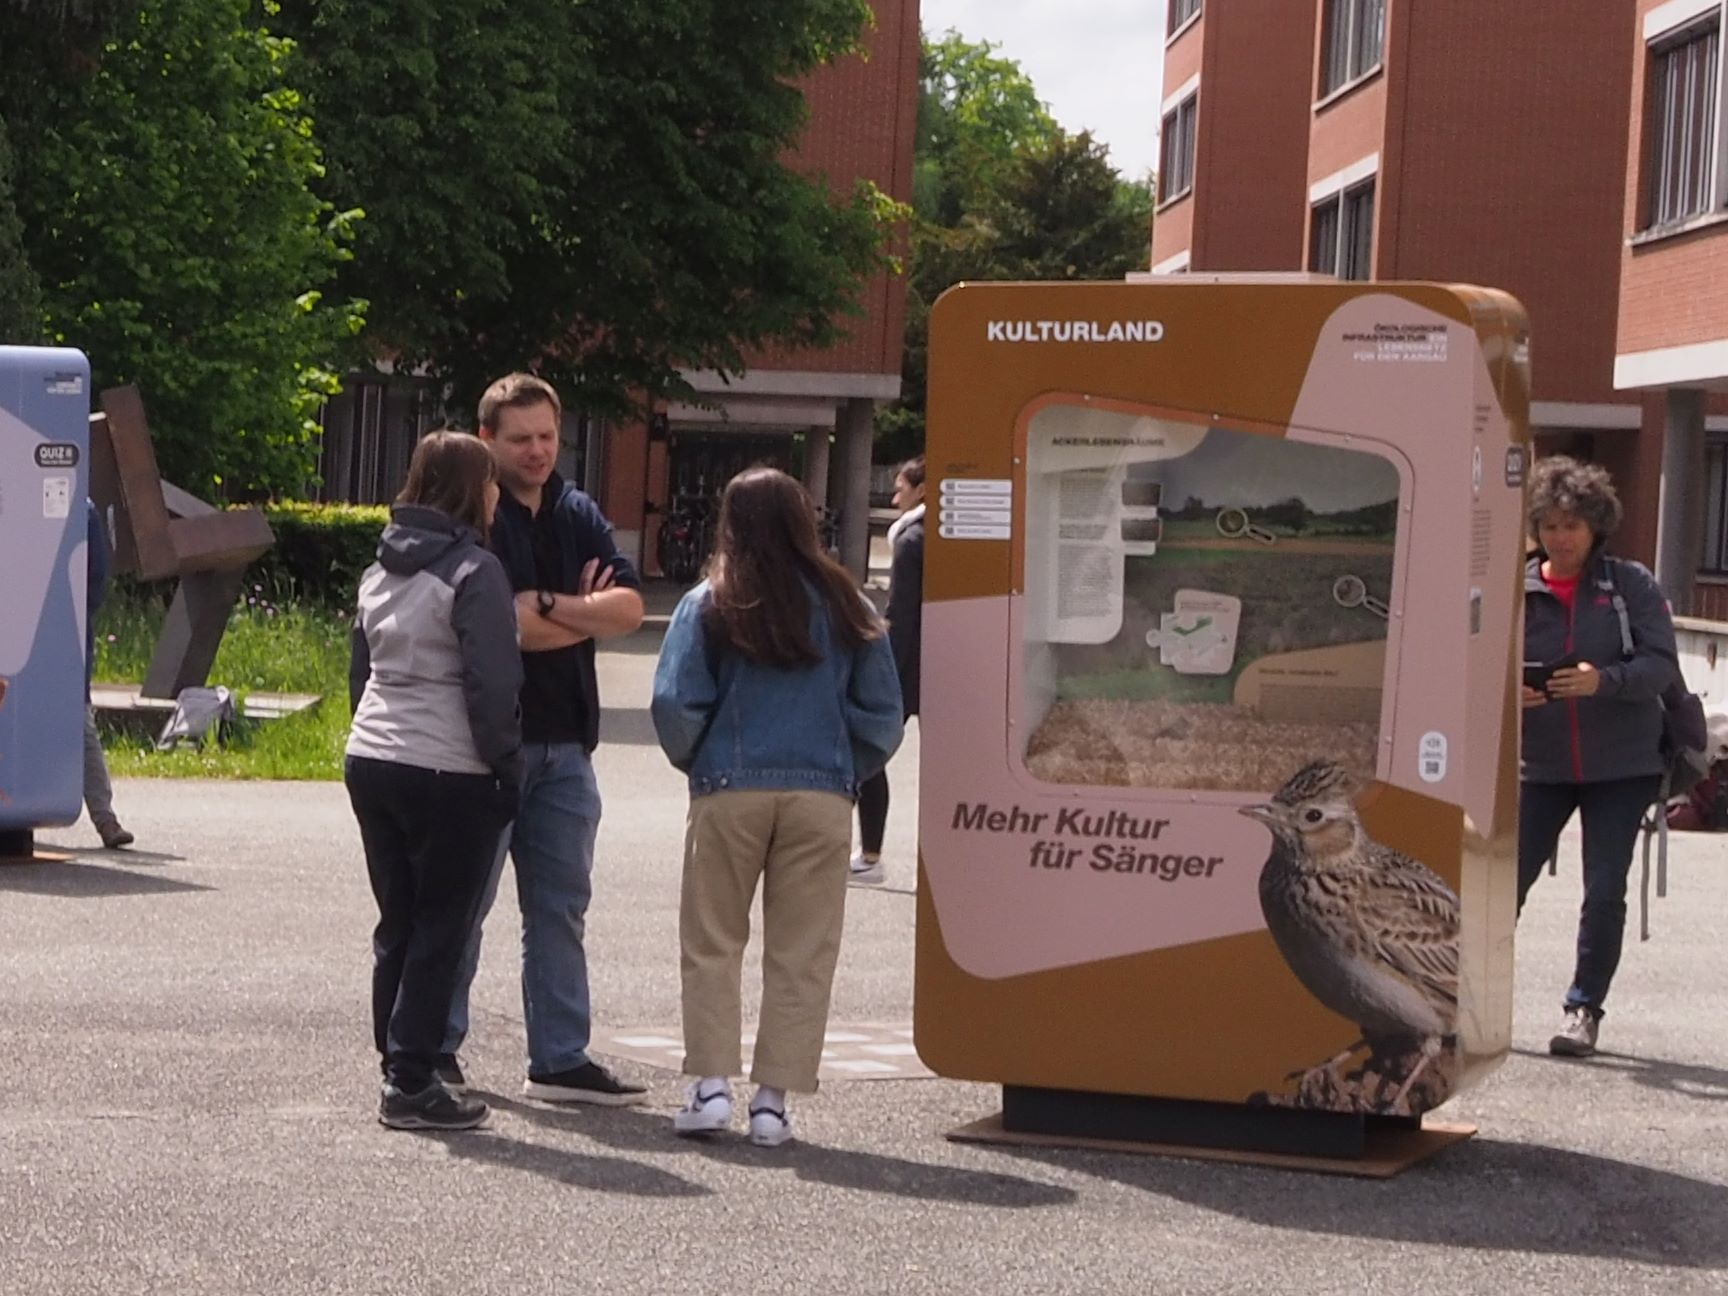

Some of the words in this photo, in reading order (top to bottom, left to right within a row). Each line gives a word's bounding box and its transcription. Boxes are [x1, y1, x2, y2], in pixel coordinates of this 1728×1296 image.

[987, 320, 1164, 342] KULTURLAND
[1342, 334, 1426, 342] INFRASTRUKTUR
[40, 447, 64, 458] QUIZ
[951, 803, 1048, 834] Mehr
[1055, 808, 1169, 840] Kultur
[1029, 841, 1082, 869] für
[1089, 844, 1223, 881] Sänger
